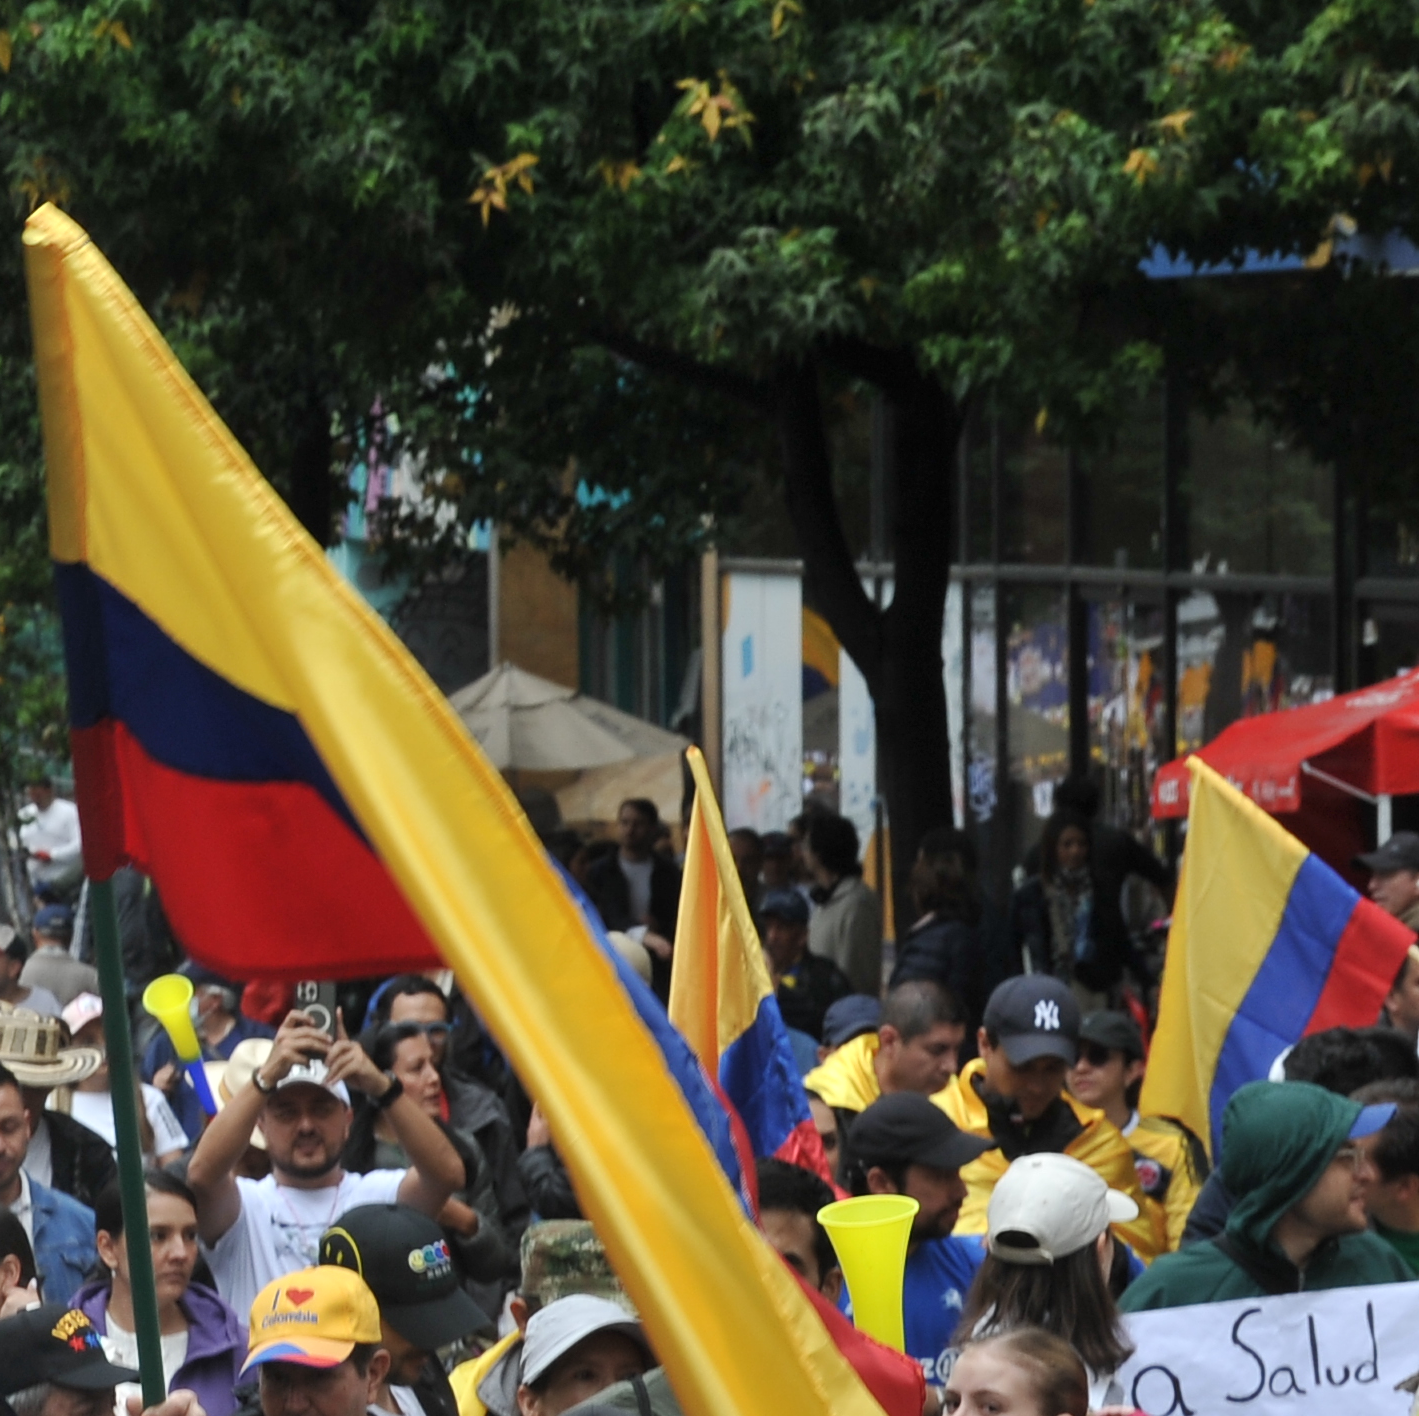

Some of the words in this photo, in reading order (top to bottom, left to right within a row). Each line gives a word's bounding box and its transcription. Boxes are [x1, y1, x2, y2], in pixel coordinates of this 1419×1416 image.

[1034, 999, 1061, 1031] NY
[271, 1288, 281, 1312] I
[1225, 1300, 1380, 1403] Salud
